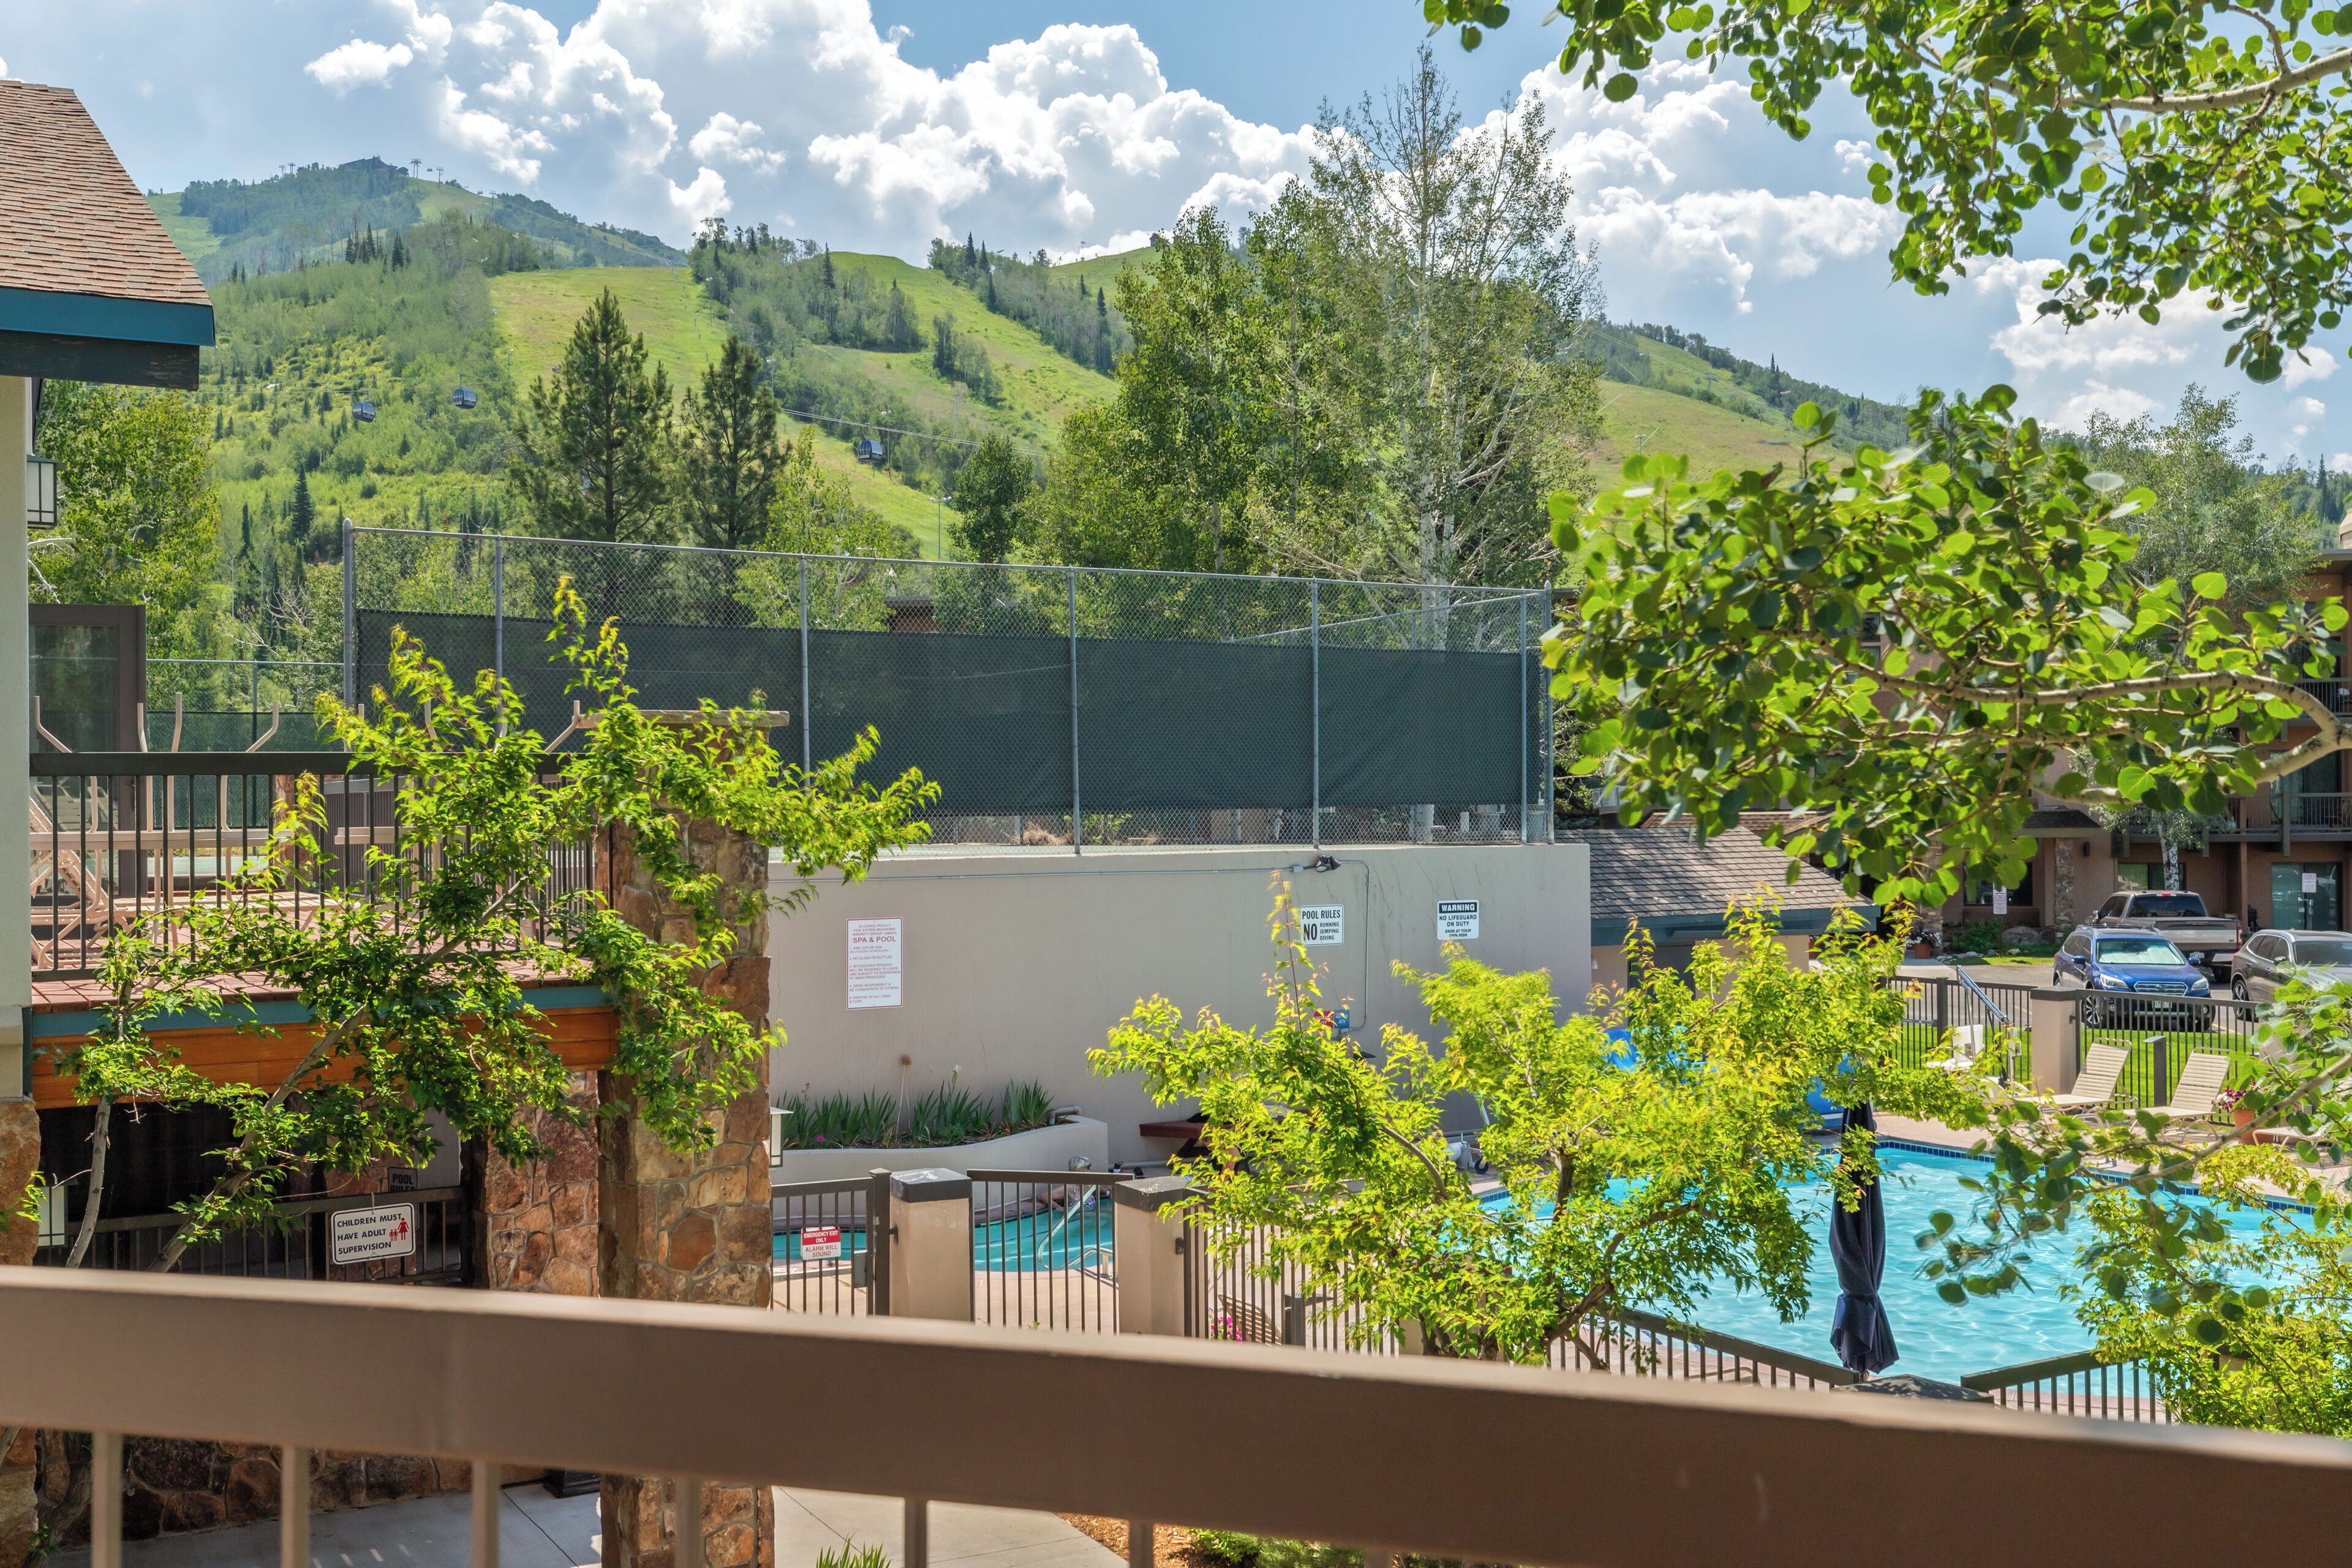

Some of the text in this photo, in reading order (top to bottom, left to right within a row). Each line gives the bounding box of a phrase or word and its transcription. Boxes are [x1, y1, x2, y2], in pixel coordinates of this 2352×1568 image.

[1303, 910, 1340, 919] POOL RULES
[1303, 924, 1317, 940] NO
[393, 1174, 413, 1185] POOL
[337, 1213, 402, 1227] CHILDREN MUST
[337, 1229, 386, 1241] HAVE ADULT
[338, 1242, 391, 1254] SUPERVISION
